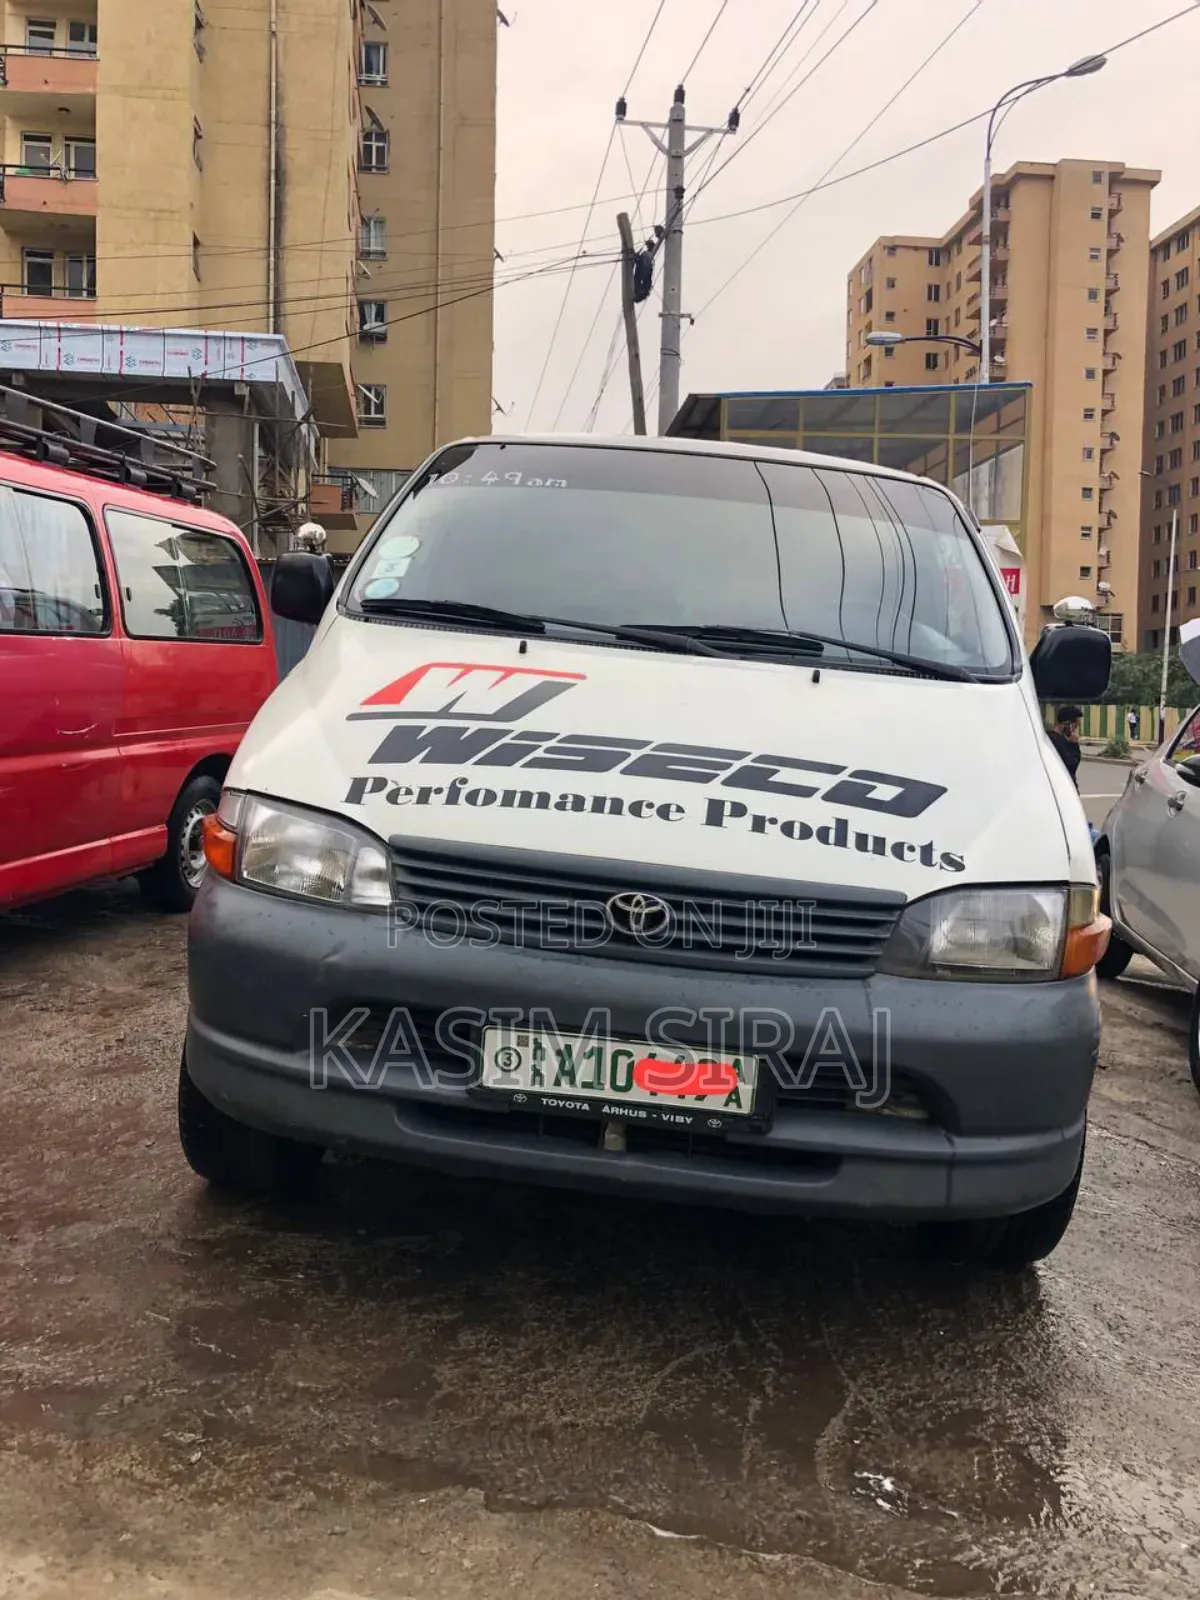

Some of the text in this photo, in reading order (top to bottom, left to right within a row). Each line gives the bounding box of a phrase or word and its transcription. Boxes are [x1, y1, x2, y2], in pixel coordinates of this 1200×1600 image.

[341, 776, 966, 872] Perfomance Products
[541, 1098, 590, 1111] TOYOTA
[661, 1113, 693, 1125] VIBY
